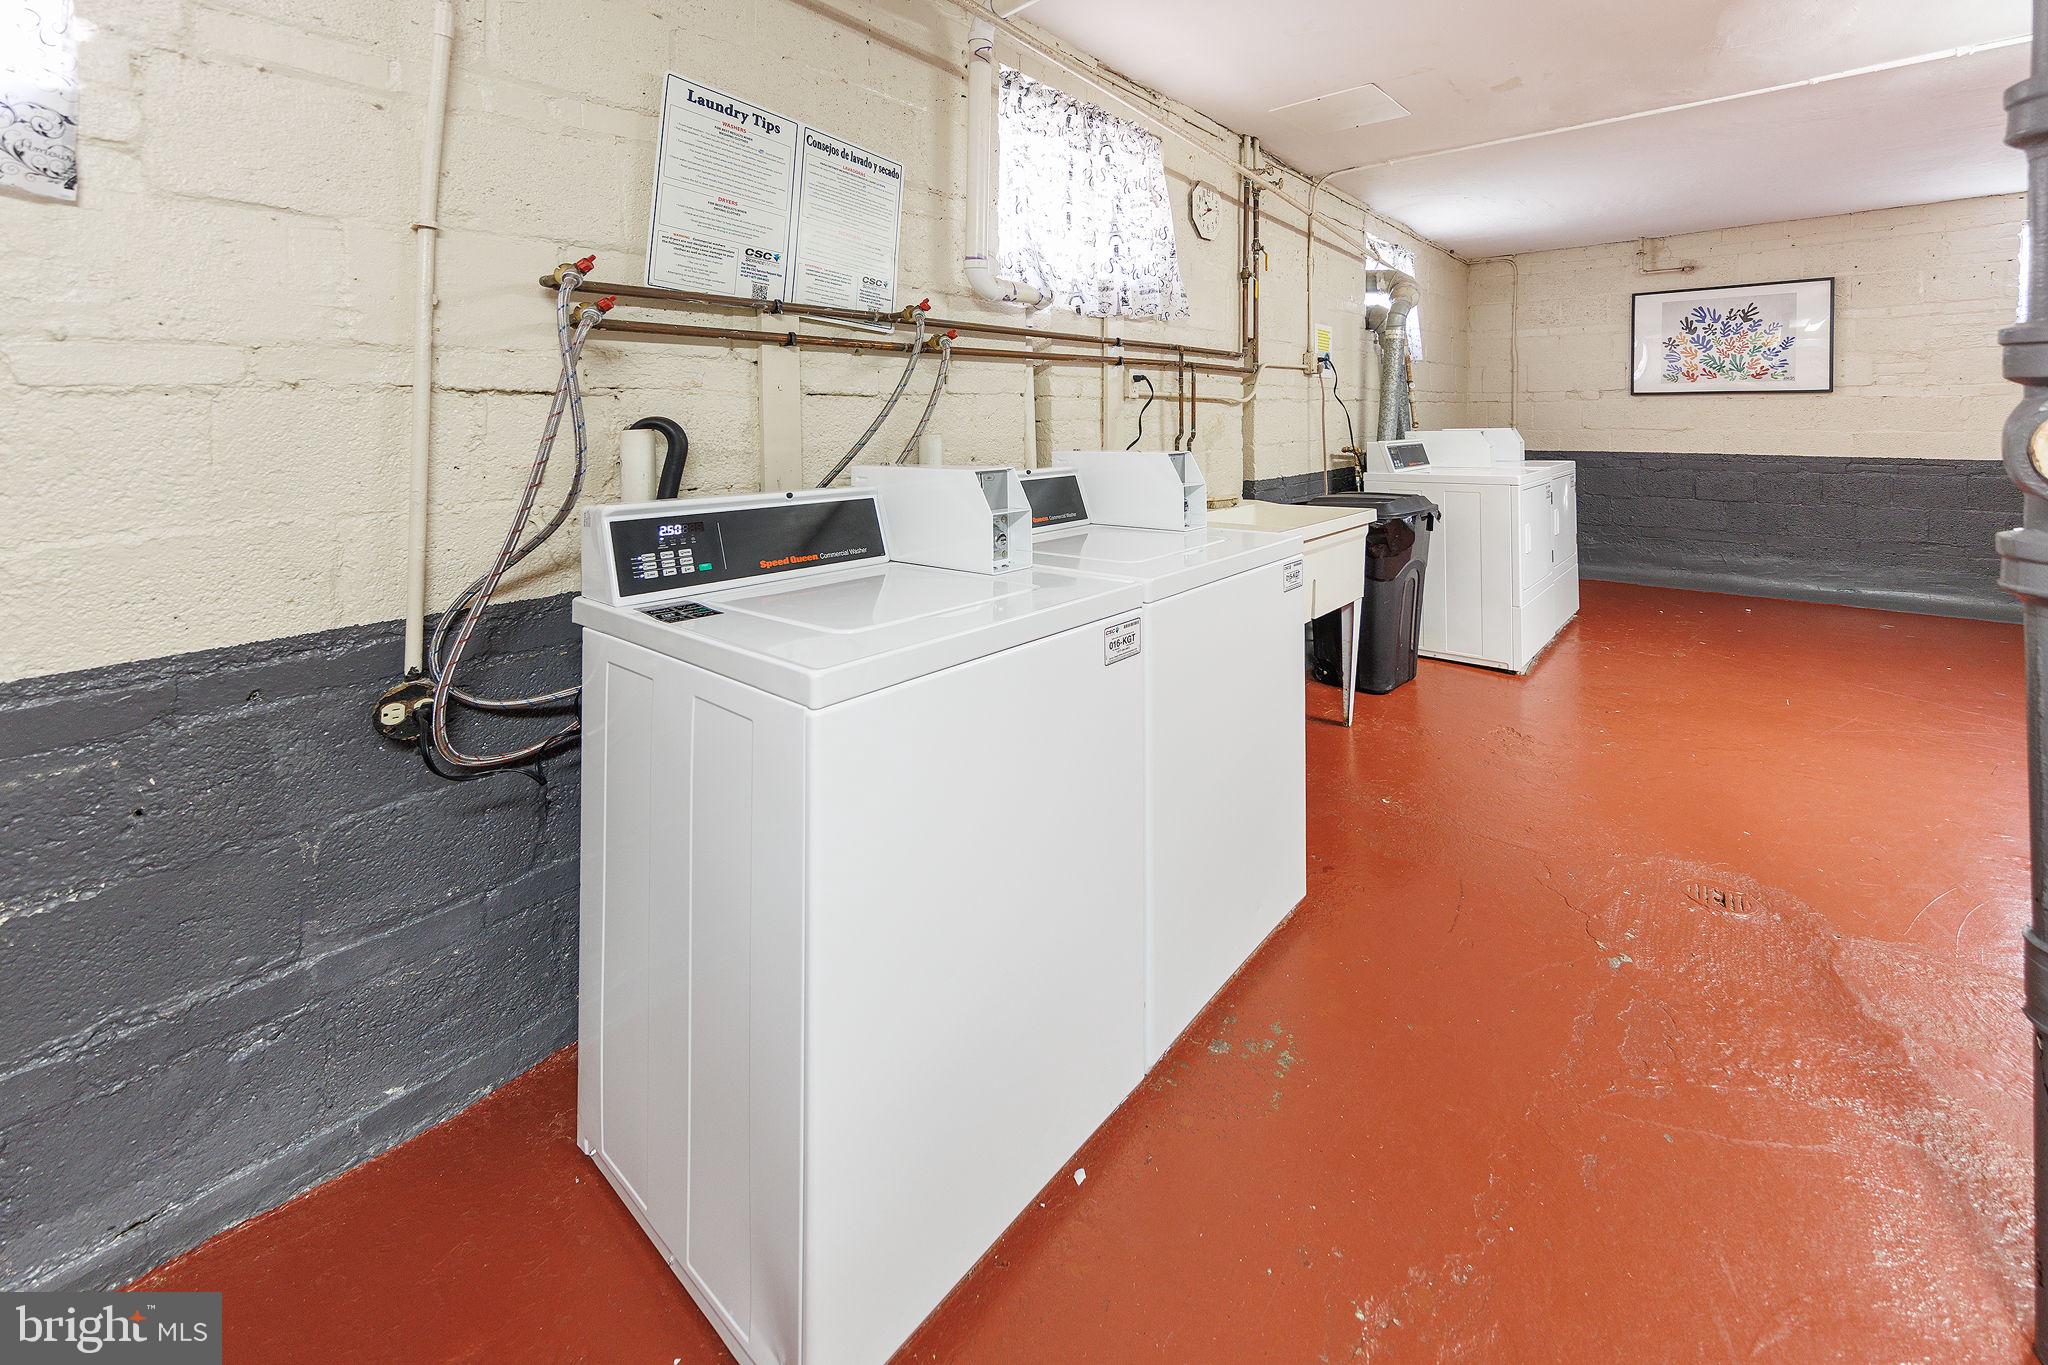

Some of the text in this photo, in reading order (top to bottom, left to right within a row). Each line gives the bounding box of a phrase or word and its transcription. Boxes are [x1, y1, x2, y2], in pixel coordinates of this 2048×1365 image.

[687, 89, 781, 134] Laundry Tips
[722, 121, 746, 134] WASHERS
[806, 134, 840, 156] Consejos
[840, 148, 850, 161] de
[850, 151, 873, 169] lavado
[873, 162, 878, 173] y
[878, 166, 900, 180] secado
[718, 196, 738, 207] DRYERS
[745, 248, 773, 261] CSC
[862, 276, 882, 287] CSC
[759, 546, 868, 569] Speed Queen Commercial Washer
